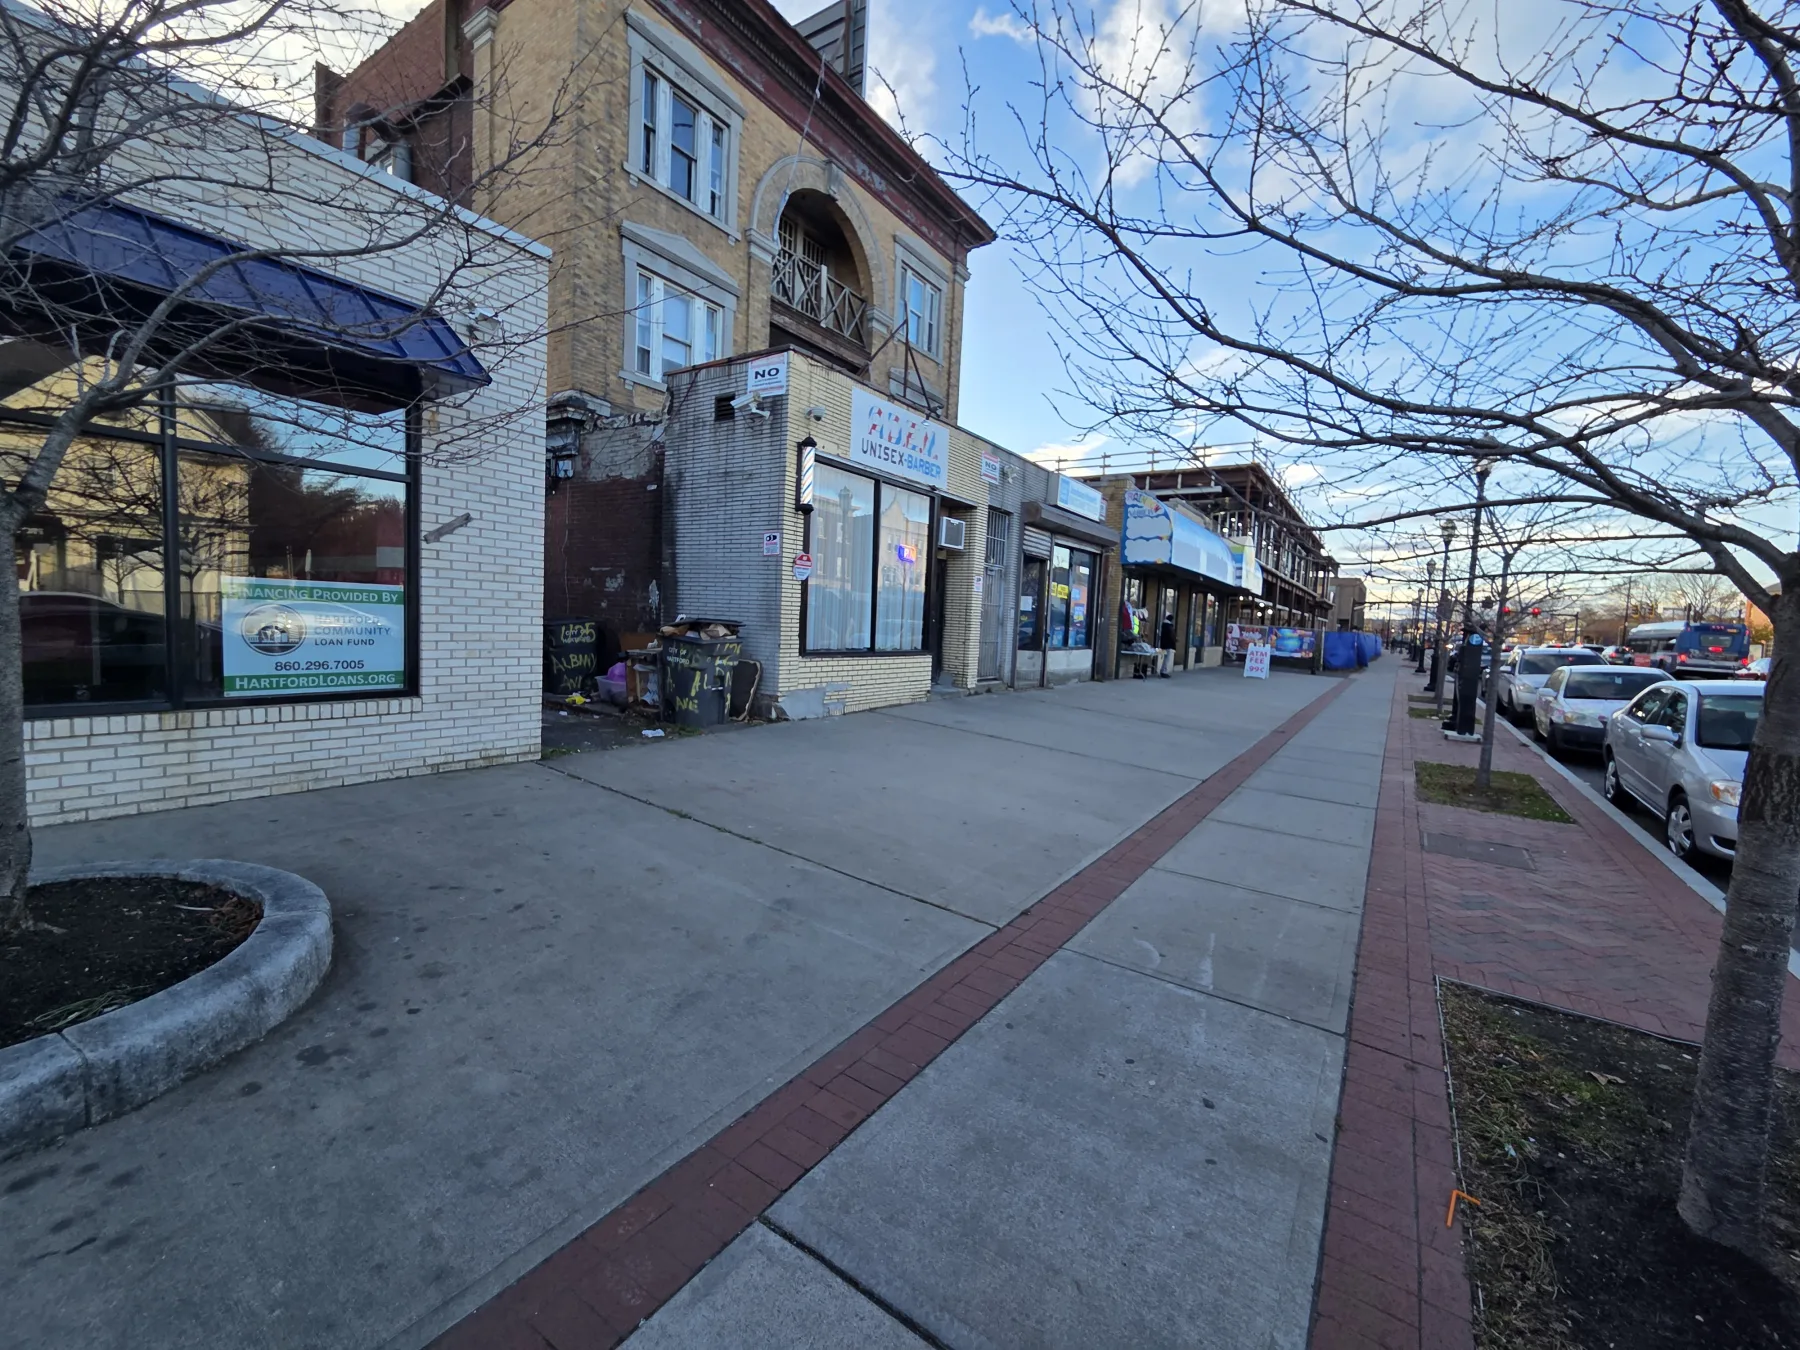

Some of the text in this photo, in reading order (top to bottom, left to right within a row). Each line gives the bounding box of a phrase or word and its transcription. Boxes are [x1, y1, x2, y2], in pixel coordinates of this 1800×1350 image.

[754, 367, 780, 380] NO
[985, 461, 997, 471] NO
[313, 588, 378, 602] PROVIDED
[382, 591, 398, 603] BY
[314, 626, 391, 636] COMMUNITY
[314, 638, 375, 646] LOAN FUND
[274, 659, 365, 671] 860.296.7005
[235, 673, 396, 690] HARTFORDLOANS.ORG
